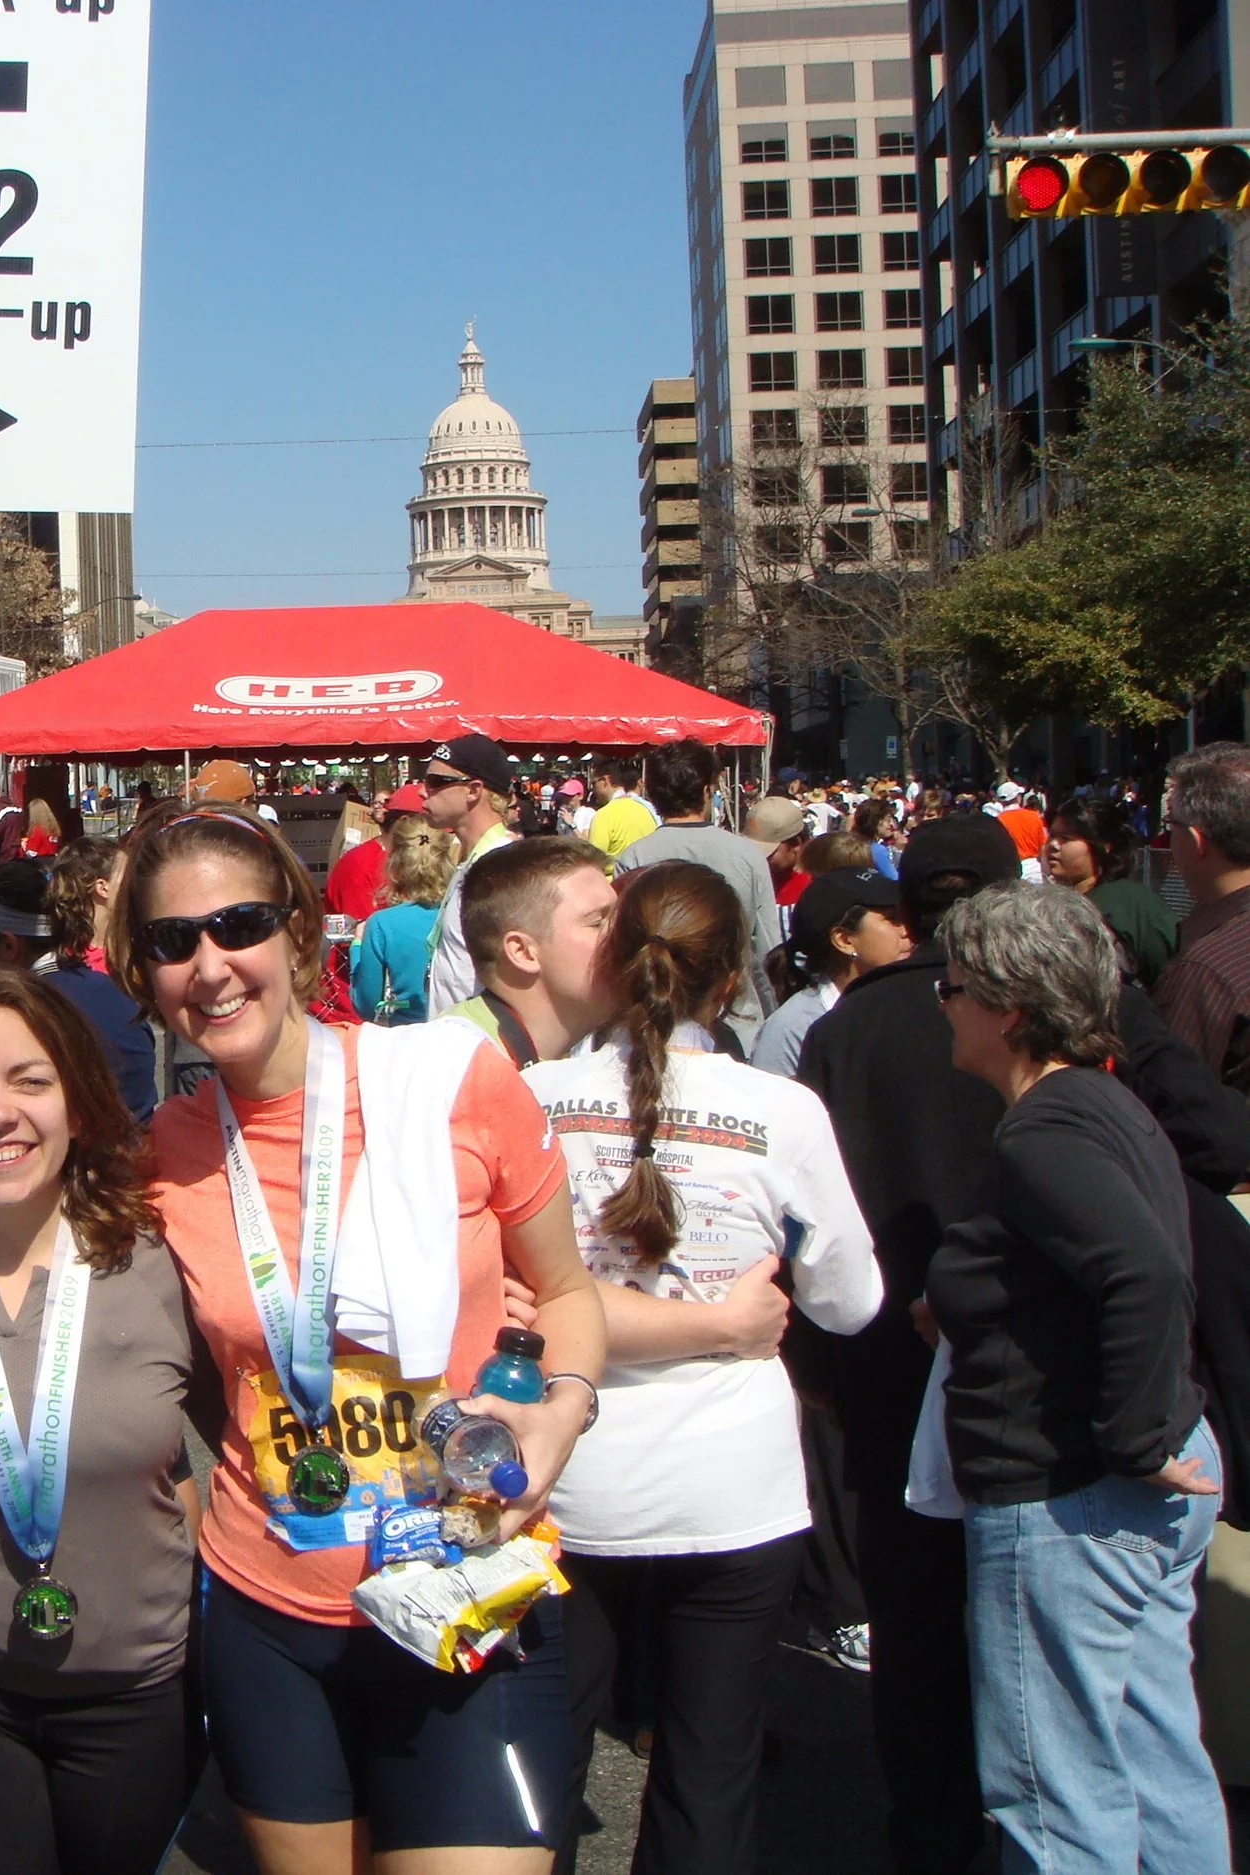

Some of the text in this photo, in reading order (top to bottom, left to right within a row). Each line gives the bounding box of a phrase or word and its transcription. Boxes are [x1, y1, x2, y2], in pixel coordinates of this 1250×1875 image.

[1111, 59, 1126, 91] ART
[1120, 219, 1134, 283] AUSTIN
[193, 699, 460, 717] Here Everything's Better.
[541, 1098, 768, 1139] DALLAS HITE ROCK
[684, 1125, 748, 1151] 2004
[656, 1150, 694, 1166] HOSPITAL
[689, 1230, 729, 1243] BELO
[260, 1292, 279, 1340] FEBRUARY
[268, 1289, 286, 1322] 18TH
